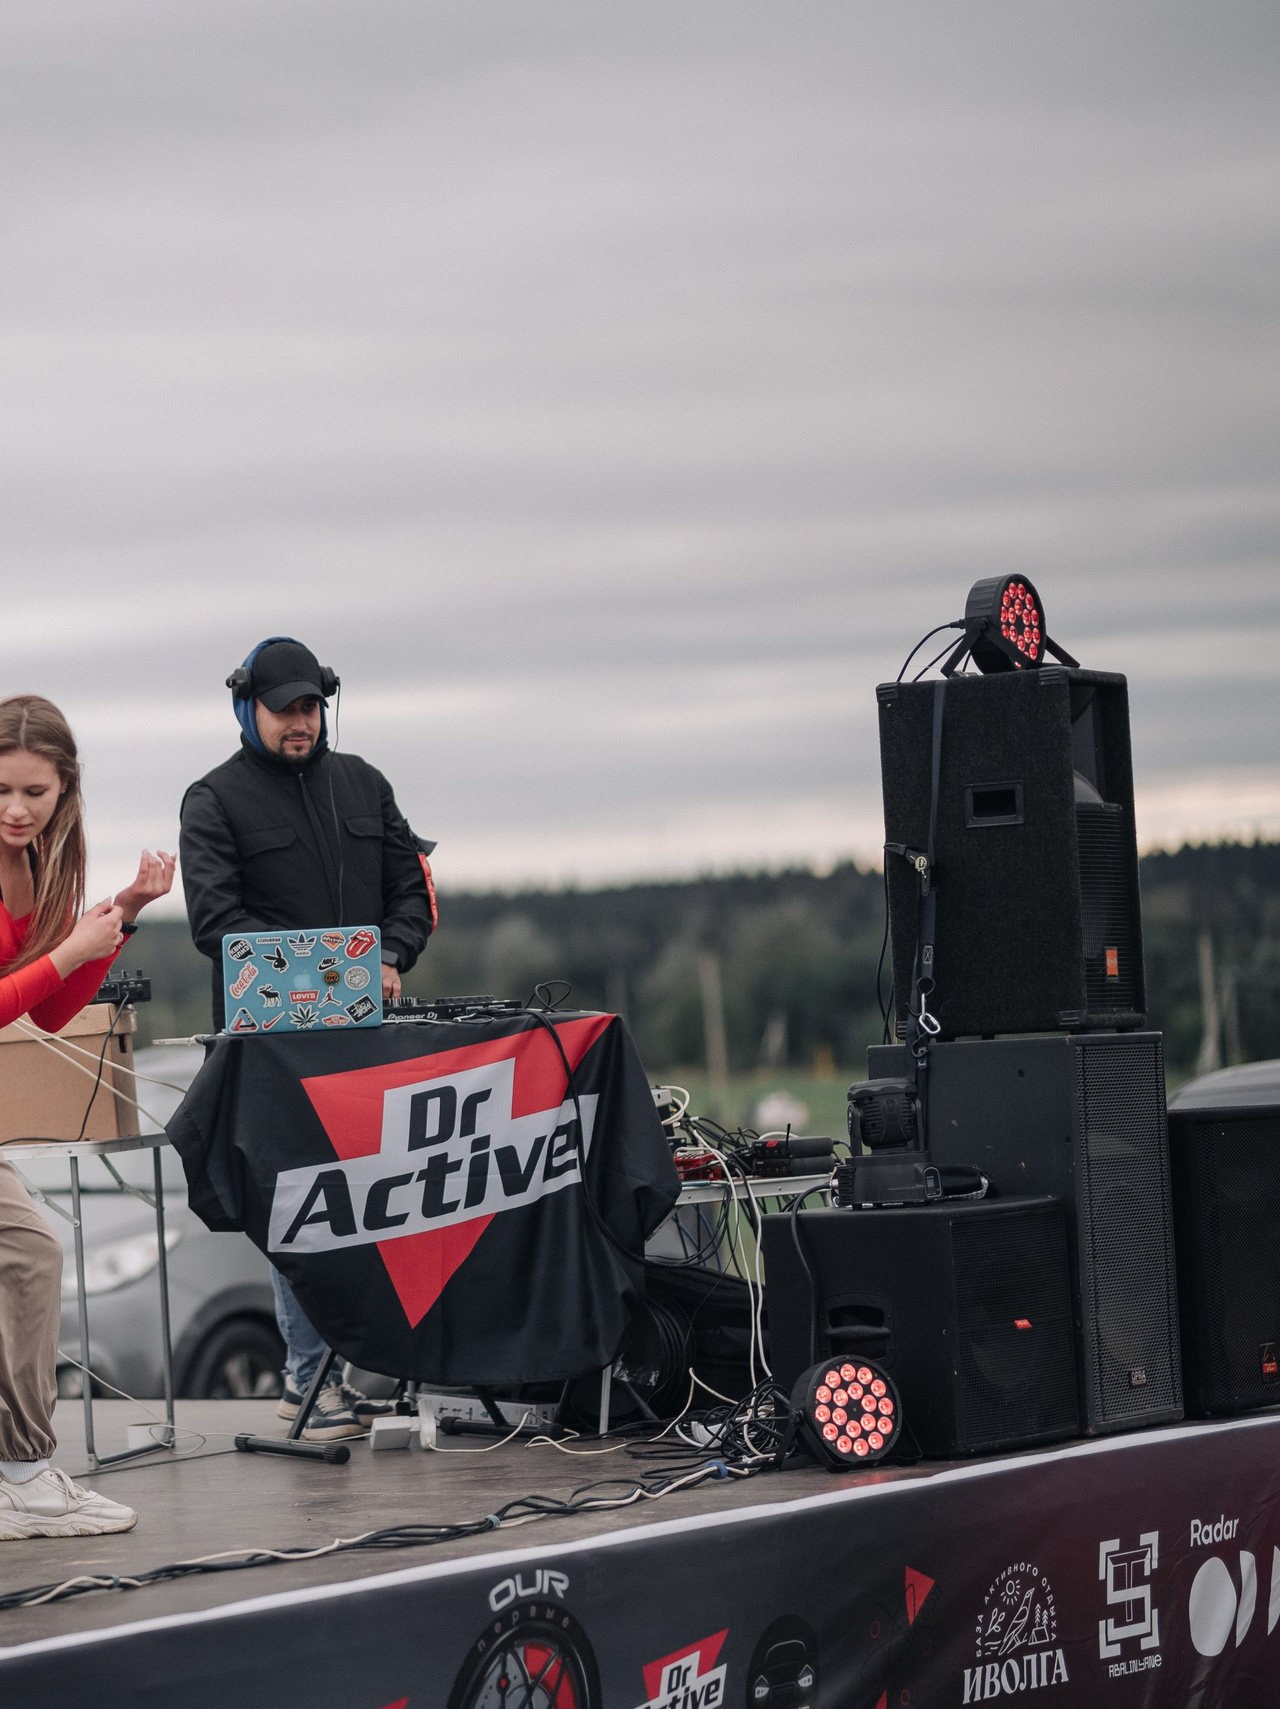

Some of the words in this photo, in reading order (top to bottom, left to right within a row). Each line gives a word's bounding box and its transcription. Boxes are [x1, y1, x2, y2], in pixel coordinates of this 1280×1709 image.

[321, 957, 338, 965] NIKE
[407, 1085, 492, 1153] Dr
[280, 1114, 581, 1245] Active
[1190, 1514, 1240, 1547] Radar
[488, 1569, 570, 1612] OUR
[975, 1614, 984, 1658] БАЗА
[984, 1562, 1039, 1605] АКТИВНОГО
[1041, 1577, 1057, 1641] ОТДЫХА
[666, 1664, 693, 1695] Dr
[962, 1648, 1070, 1705] ИВОЛГА
